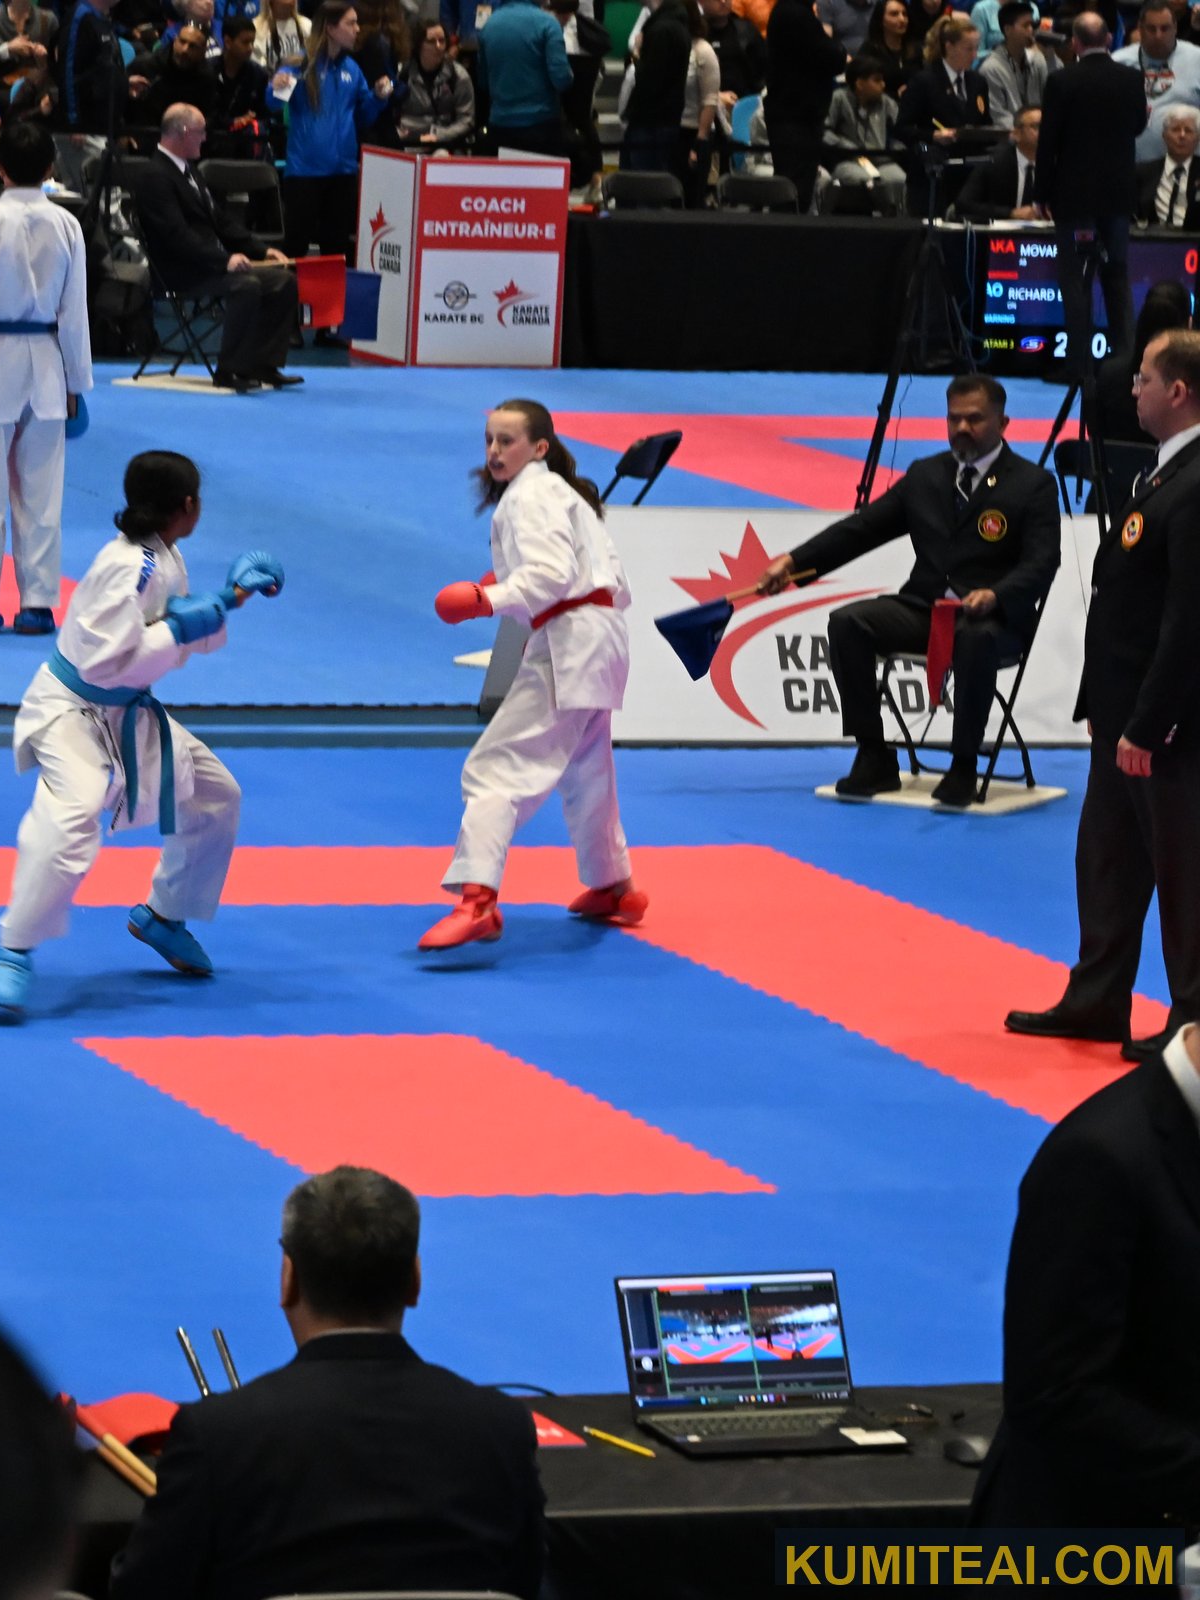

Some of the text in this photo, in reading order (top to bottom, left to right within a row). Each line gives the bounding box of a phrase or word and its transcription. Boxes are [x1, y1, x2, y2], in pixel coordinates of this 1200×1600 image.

[460, 197, 526, 213] COACH
[1184, 248, 1198, 274] 0
[1008, 287, 1055, 301] RICHARD
[513, 304, 549, 315] KARATE
[424, 313, 484, 324] KARATE BC
[512, 313, 550, 325] CANADA
